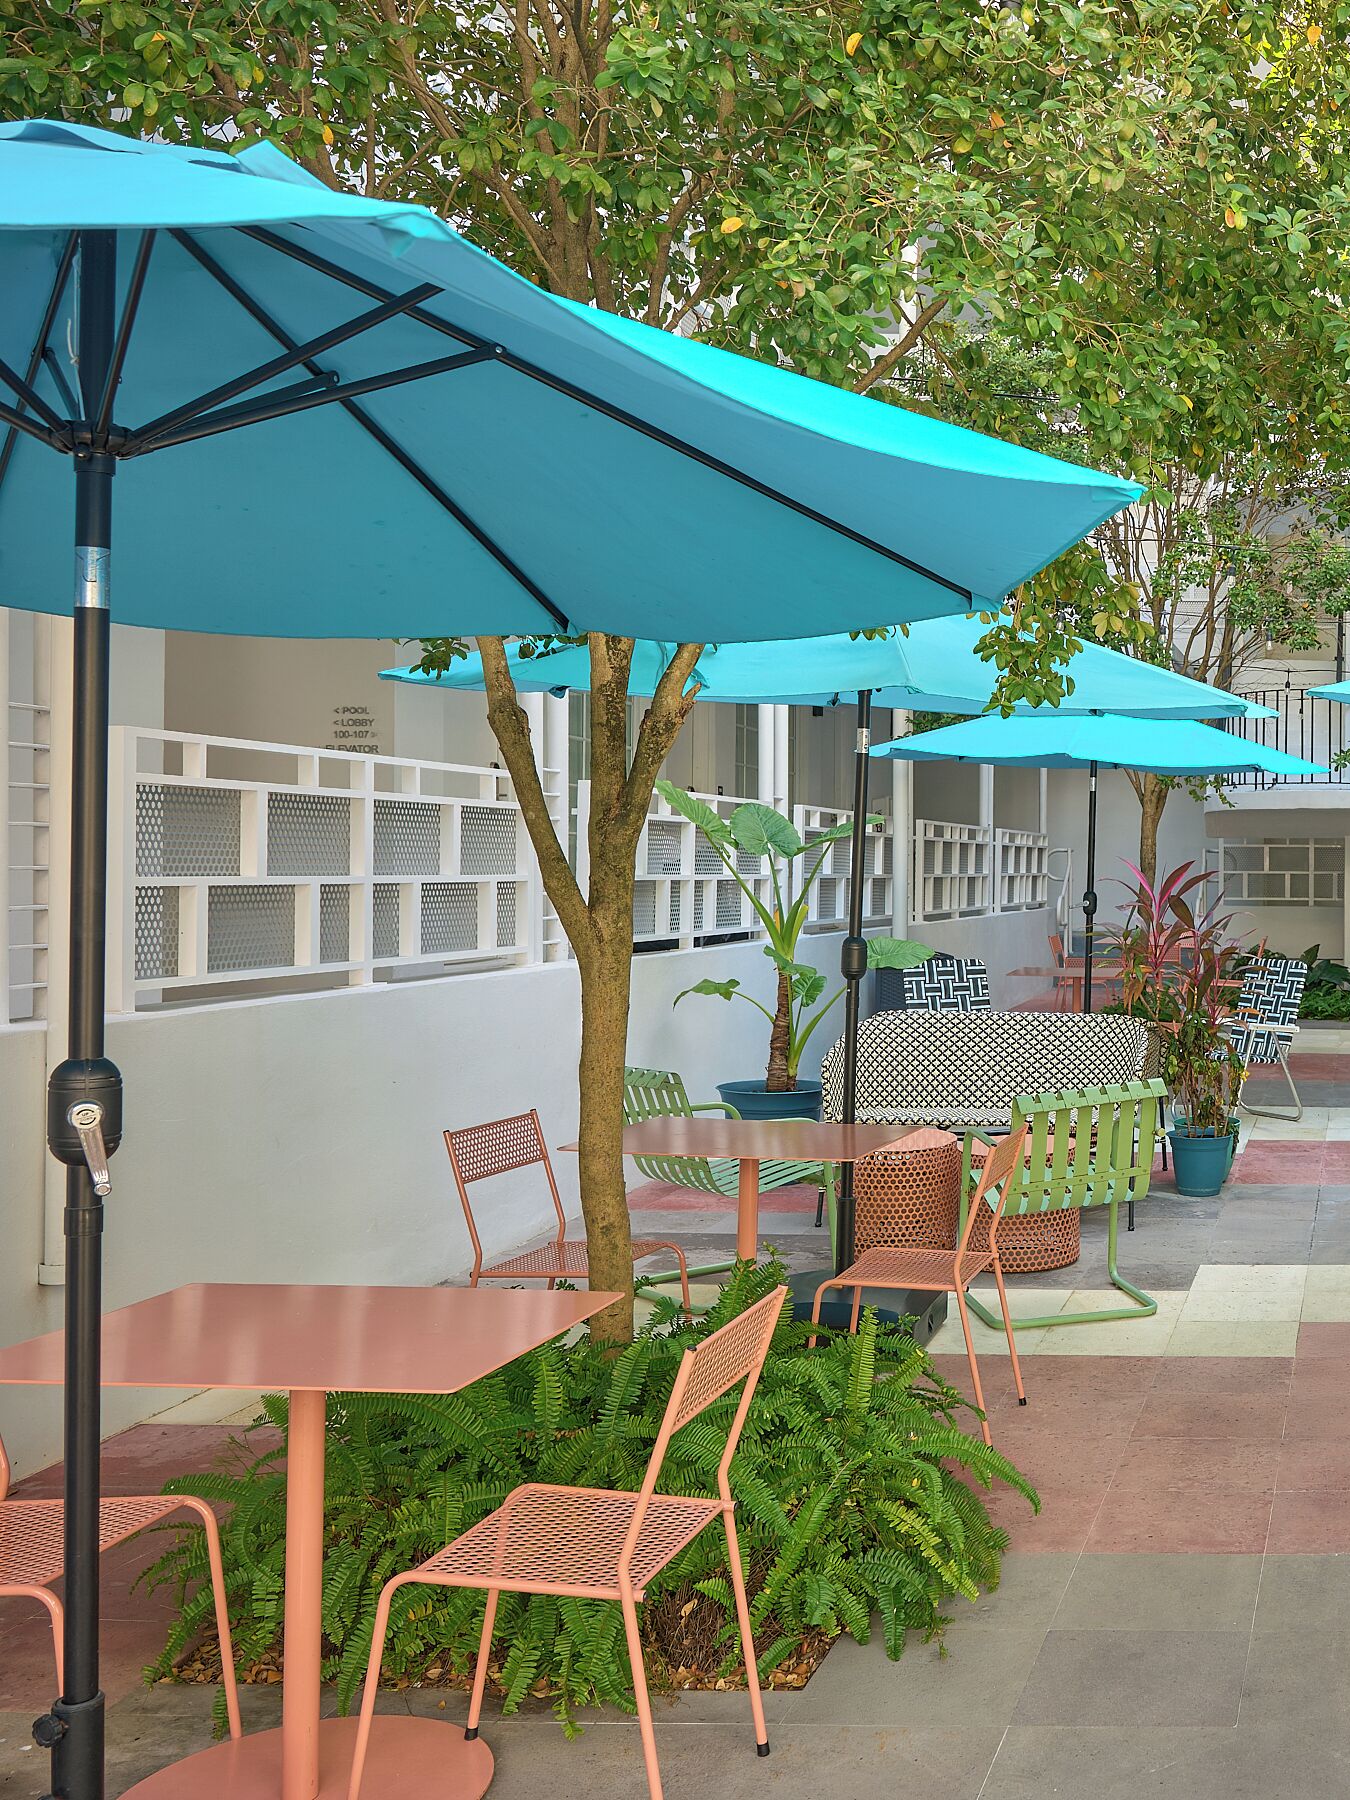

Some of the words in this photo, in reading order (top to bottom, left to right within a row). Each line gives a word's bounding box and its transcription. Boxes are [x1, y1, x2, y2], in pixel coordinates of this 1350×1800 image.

[342, 706, 370, 715] POOL
[341, 718, 375, 727] LOBBY
[334, 730, 369, 739] 100-107
